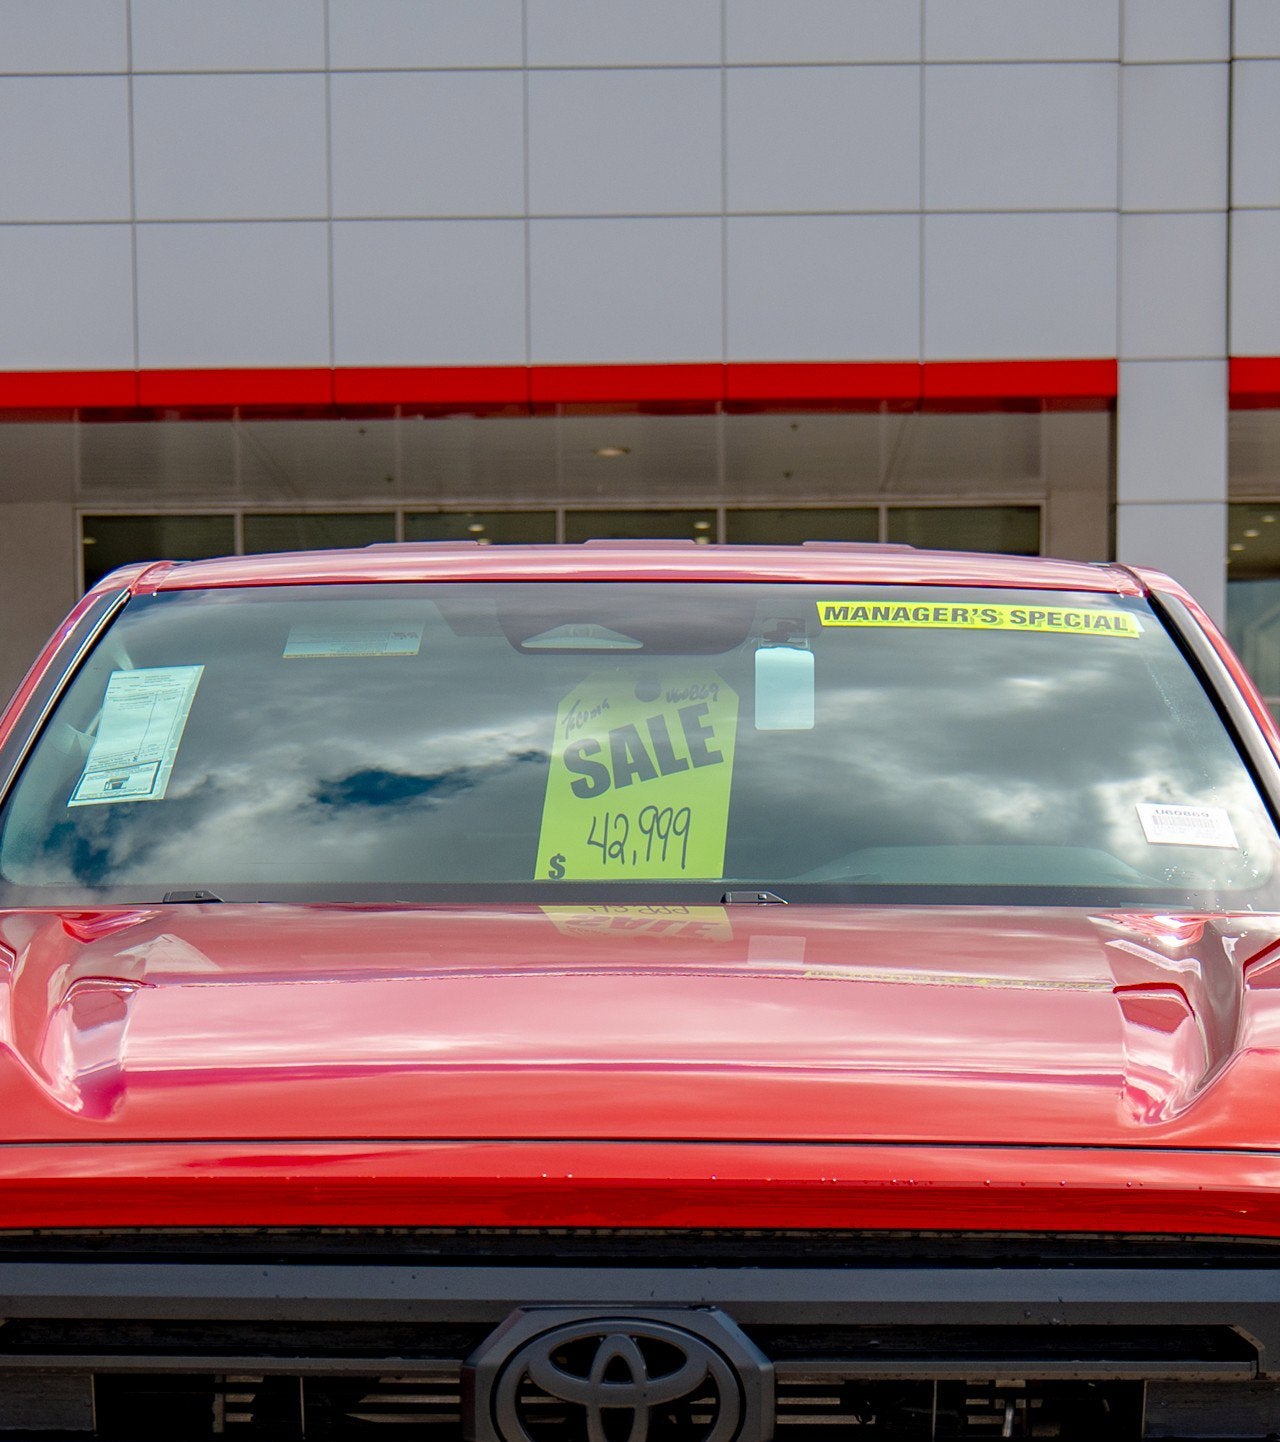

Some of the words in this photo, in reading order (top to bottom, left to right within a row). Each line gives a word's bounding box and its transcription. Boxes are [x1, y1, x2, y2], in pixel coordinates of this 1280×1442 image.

[823, 605, 999, 624] MANAGER'S
[1009, 609, 1130, 632] SPECIAL
[563, 702, 724, 799] SALE
[548, 853, 567, 880] $
[586, 804, 691, 870] 42,999
